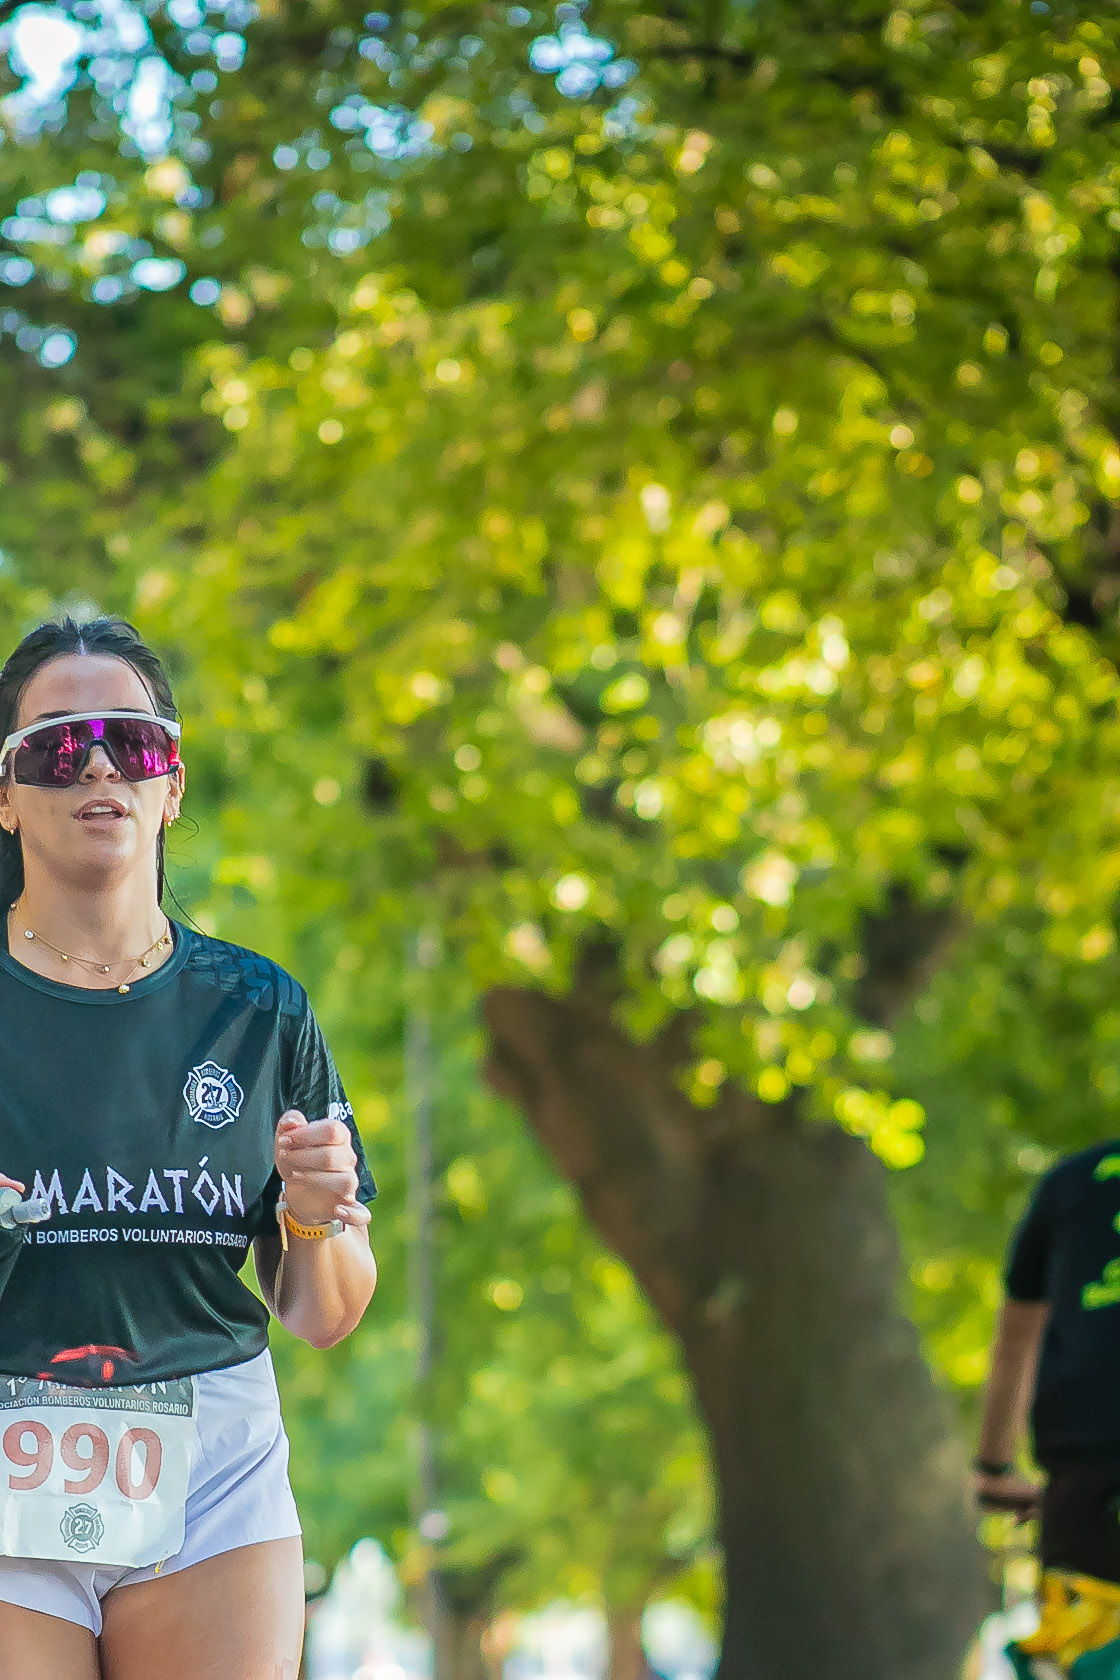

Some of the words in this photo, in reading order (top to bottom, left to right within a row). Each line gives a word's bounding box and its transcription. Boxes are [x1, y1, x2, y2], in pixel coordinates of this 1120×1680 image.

[201, 1082, 223, 1104] 27
[30, 1154, 245, 1217] MARATÓN
[22, 1231, 32, 1245] N
[36, 1228, 119, 1245] BOMBEROS
[122, 1228, 213, 1245] VOLUNTARIOS
[215, 1231, 248, 1249] ROSARIO
[41, 1395, 91, 1407] BOMBEROS
[92, 1396, 151, 1412] VOLUNTARIOS
[152, 1401, 189, 1416] ROSARIO
[3, 1420, 163, 1500] 990
[74, 1517, 93, 1535] 27
